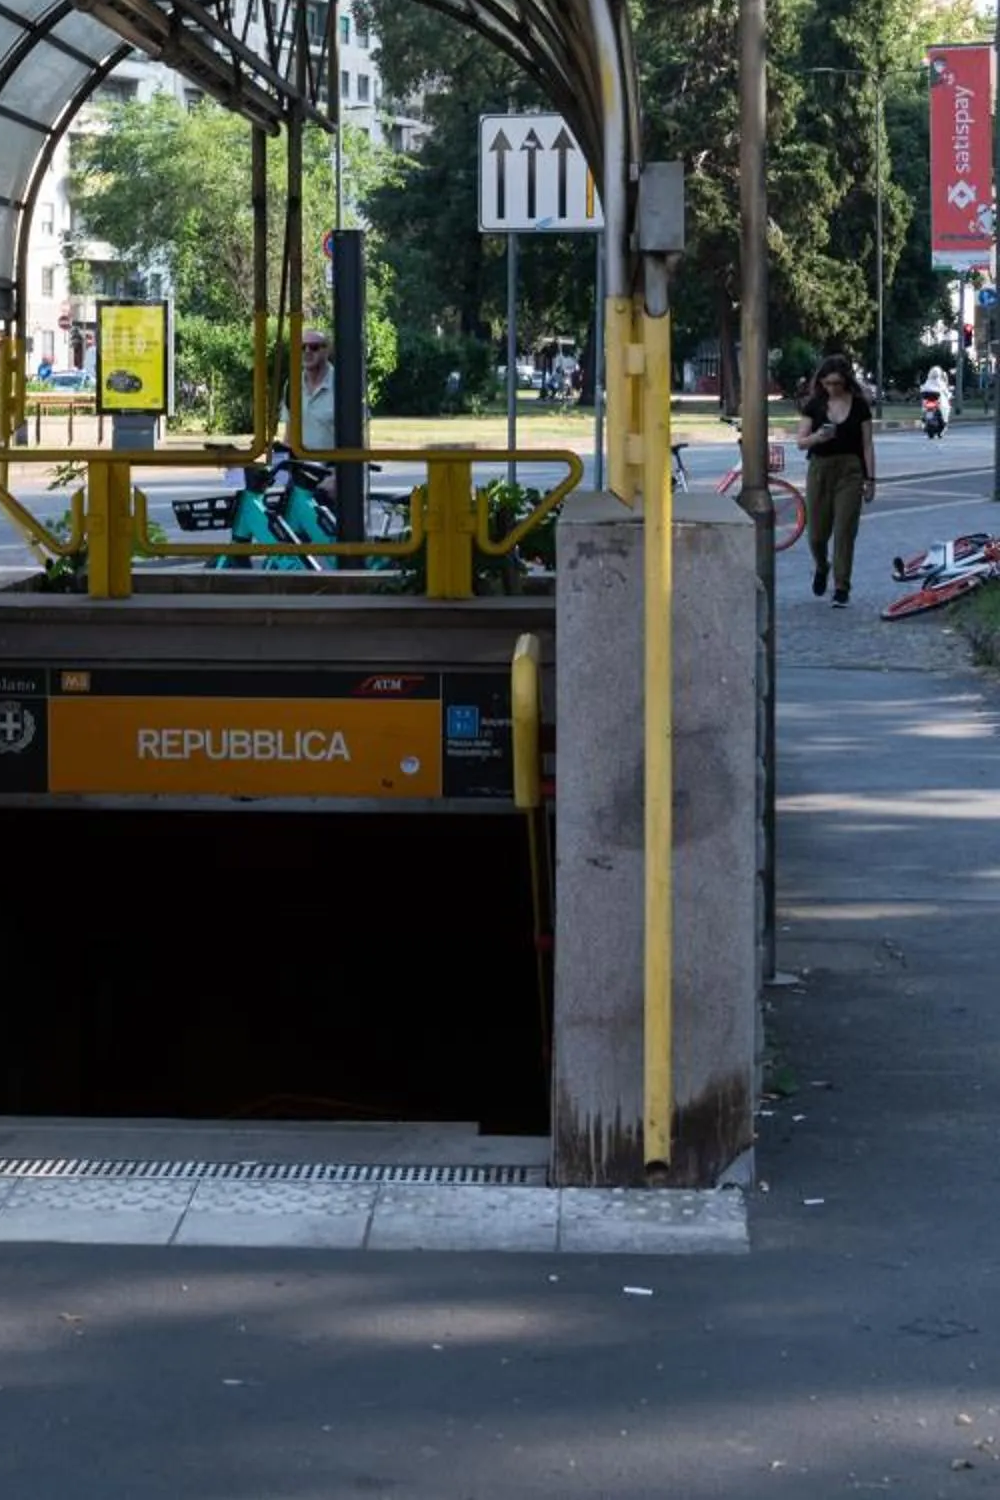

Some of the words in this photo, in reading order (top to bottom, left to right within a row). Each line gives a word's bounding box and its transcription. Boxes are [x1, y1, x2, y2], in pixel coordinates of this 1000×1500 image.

[952, 85, 976, 174] satispay
[373, 678, 402, 691] ATM
[137, 729, 351, 762] REPUBBLICA
